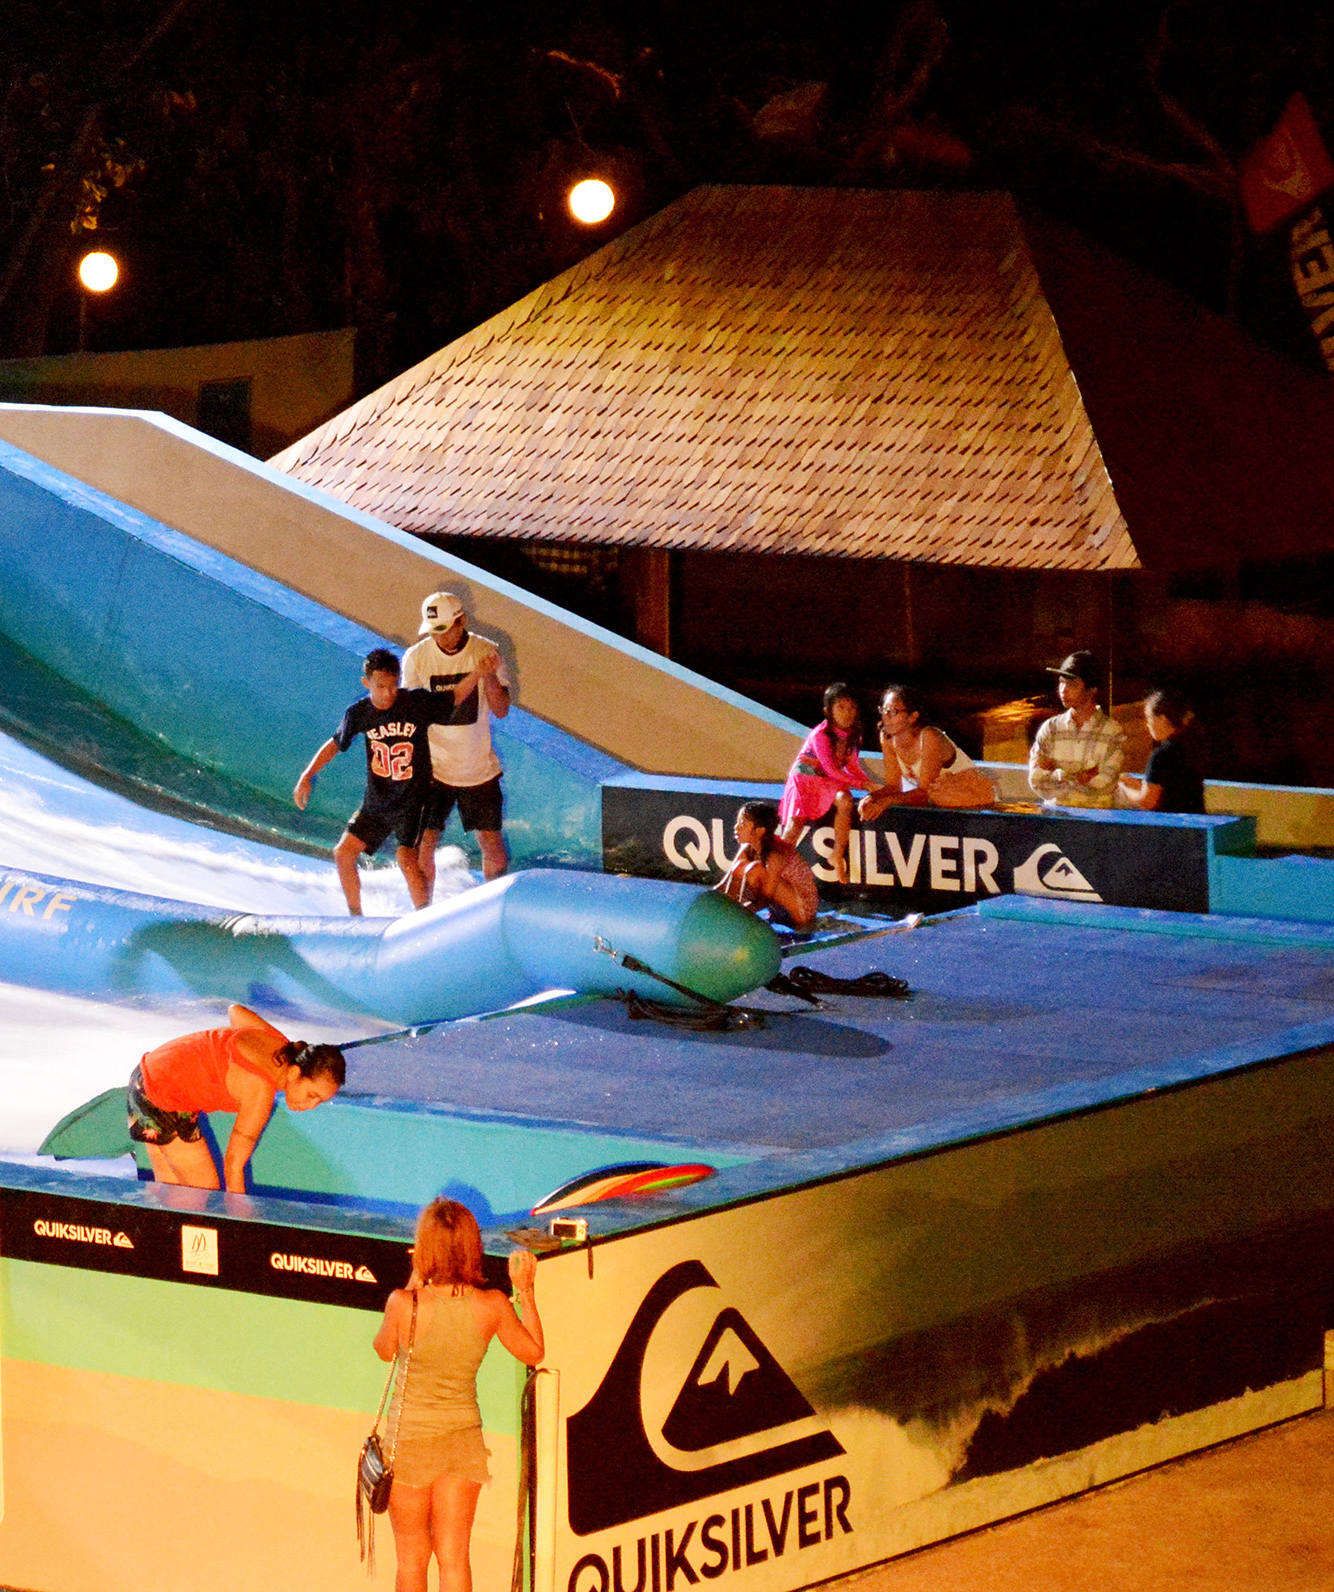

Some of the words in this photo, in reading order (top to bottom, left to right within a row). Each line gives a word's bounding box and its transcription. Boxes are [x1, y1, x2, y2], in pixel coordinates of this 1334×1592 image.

[371, 740, 414, 780] 02
[663, 815, 1000, 894] QUSILVER
[33, 1220, 112, 1246] QUIKSILVER
[270, 1252, 354, 1280] QUIKSILVER
